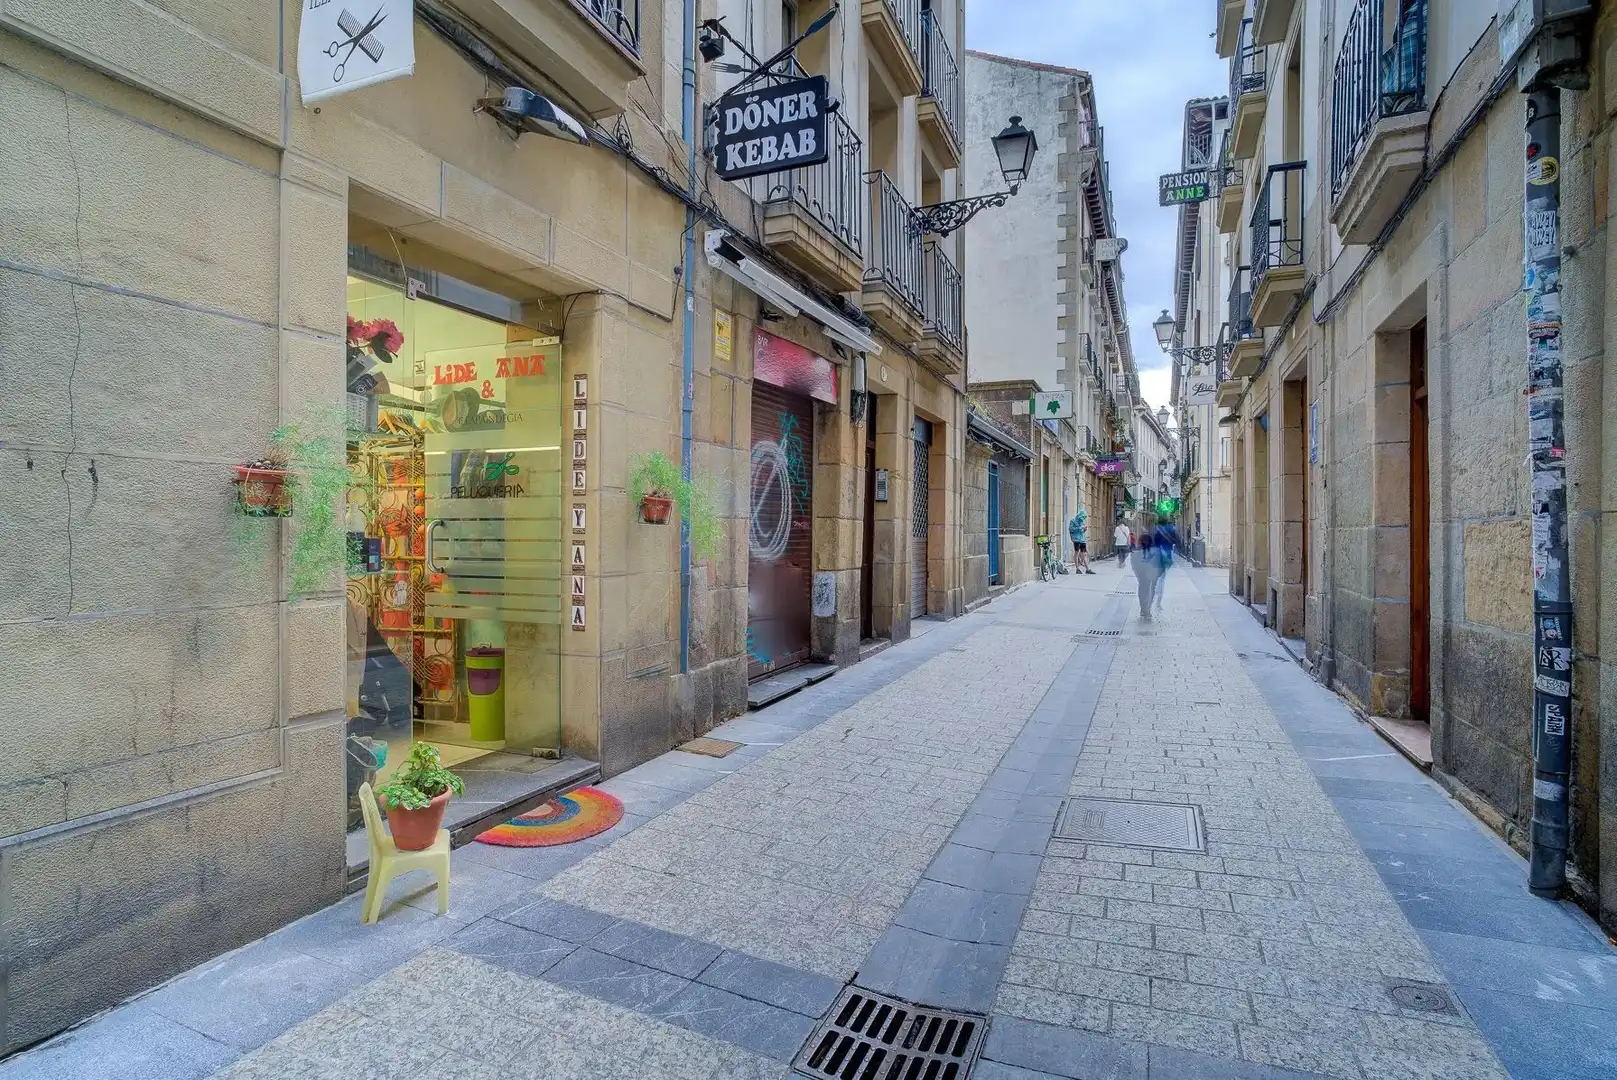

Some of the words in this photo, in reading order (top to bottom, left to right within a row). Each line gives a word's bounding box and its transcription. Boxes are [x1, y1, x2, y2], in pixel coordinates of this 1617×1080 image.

[724, 90, 818, 135] DÖNER
[725, 128, 817, 171] KEBAB
[1165, 185, 1205, 202] ANNE
[495, 354, 546, 378] ANA
[481, 379, 495, 399] &
[574, 380, 586, 489] LIDE
[450, 483, 525, 499] PELUQUERIA
[573, 508, 584, 527] Y
[573, 546, 584, 625] ANA
